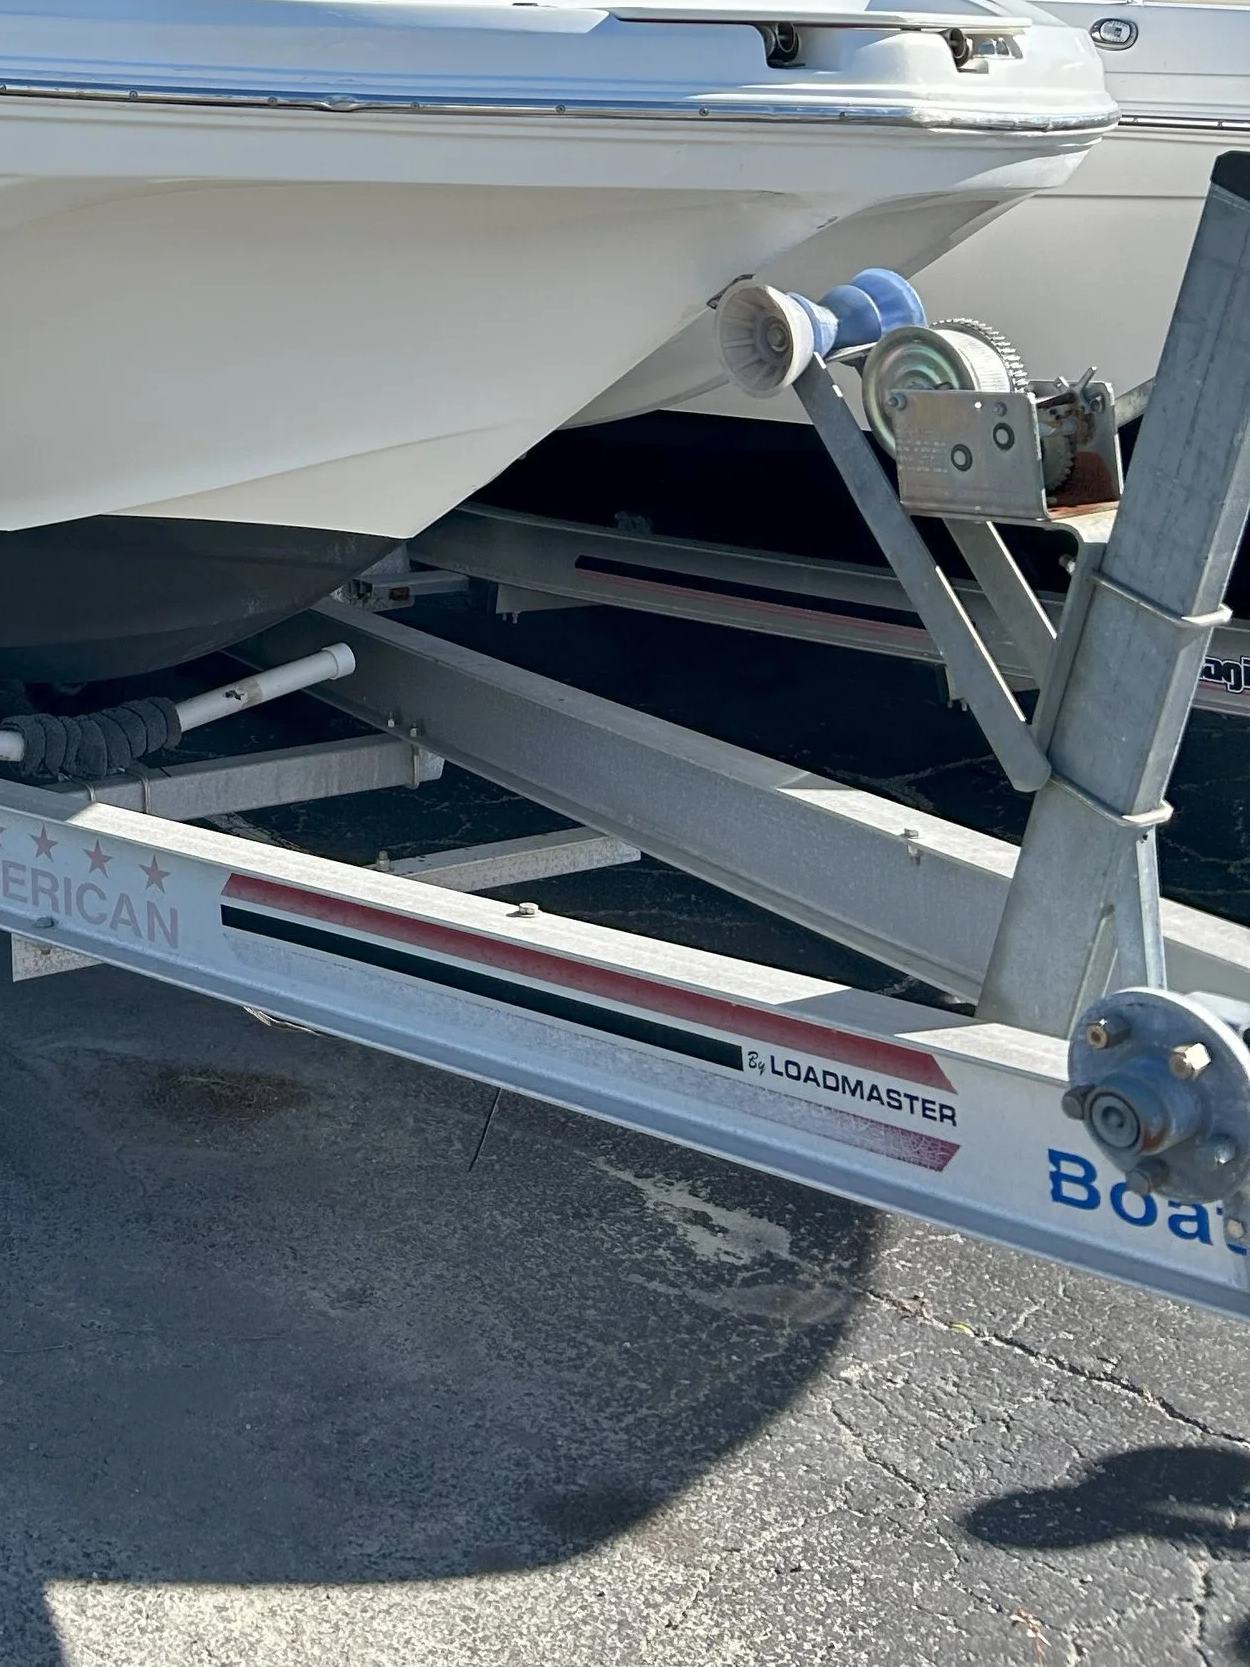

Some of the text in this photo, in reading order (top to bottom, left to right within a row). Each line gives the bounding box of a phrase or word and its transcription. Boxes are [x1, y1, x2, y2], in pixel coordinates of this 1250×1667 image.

[747, 1050, 958, 1127] By LOADMASTER
[1048, 1148, 1248, 1256] Boa
